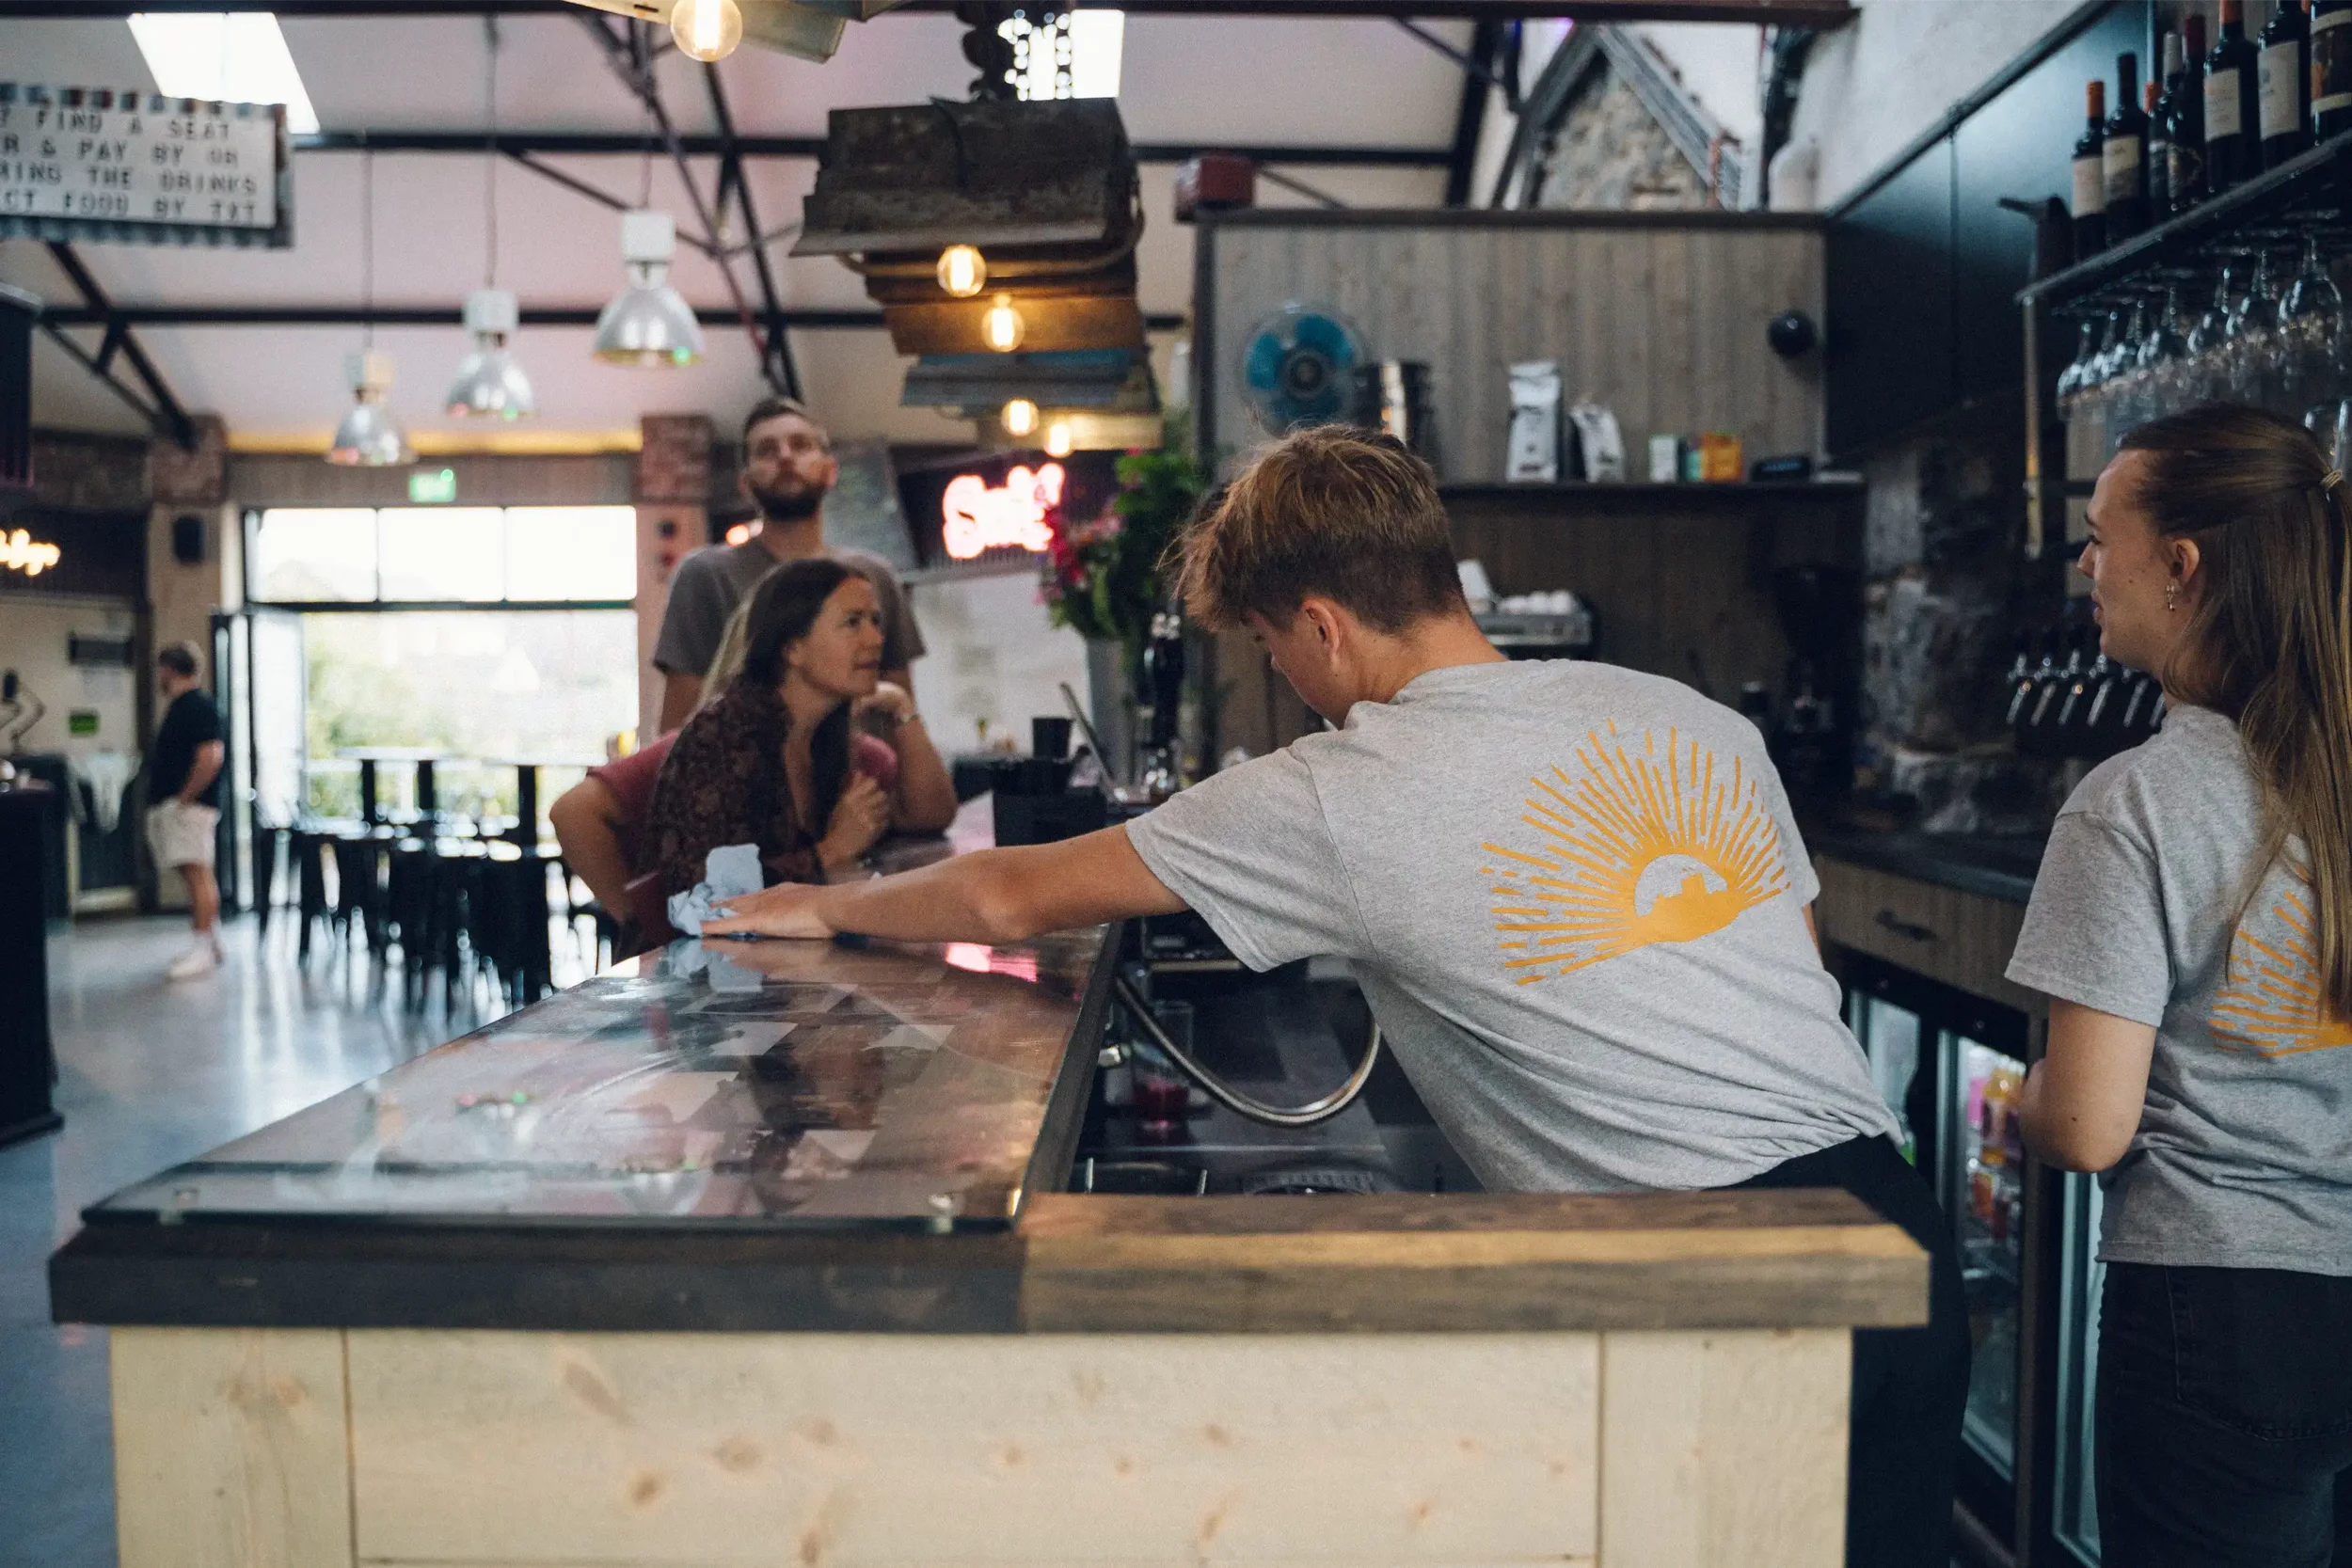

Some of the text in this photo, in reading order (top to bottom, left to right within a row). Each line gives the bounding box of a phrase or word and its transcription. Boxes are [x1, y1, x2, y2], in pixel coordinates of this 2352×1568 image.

[37, 108, 103, 135] FIND
[129, 115, 143, 135] A
[168, 119, 230, 140] SEAT
[77, 137, 127, 161] PAY
[151, 143, 184, 166] BY
[87, 166, 133, 190] THE
[159, 169, 258, 197] DRINKS
